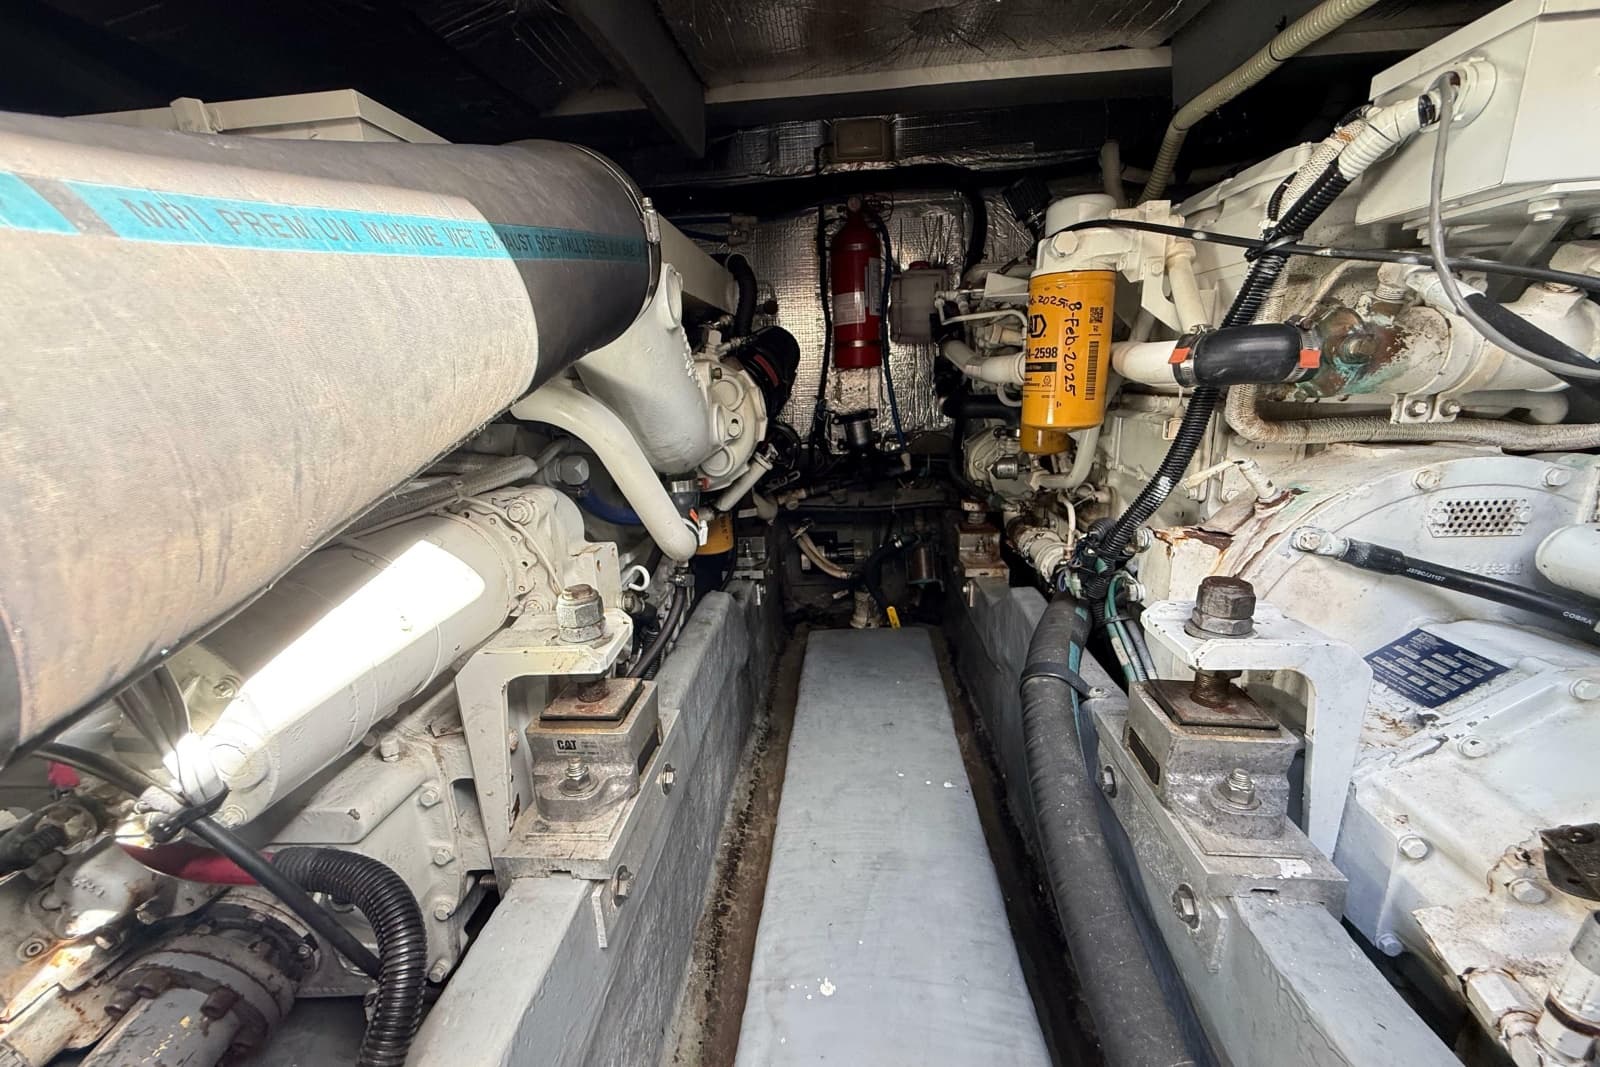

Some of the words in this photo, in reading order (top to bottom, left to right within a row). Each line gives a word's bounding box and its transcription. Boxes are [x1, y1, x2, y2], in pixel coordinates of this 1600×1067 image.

[119, 197, 214, 233] MPI
[360, 220, 444, 247] MARINE
[442, 225, 479, 249] WET
[1562, 611, 1592, 625] COBRA
[556, 739, 577, 750] CAT
